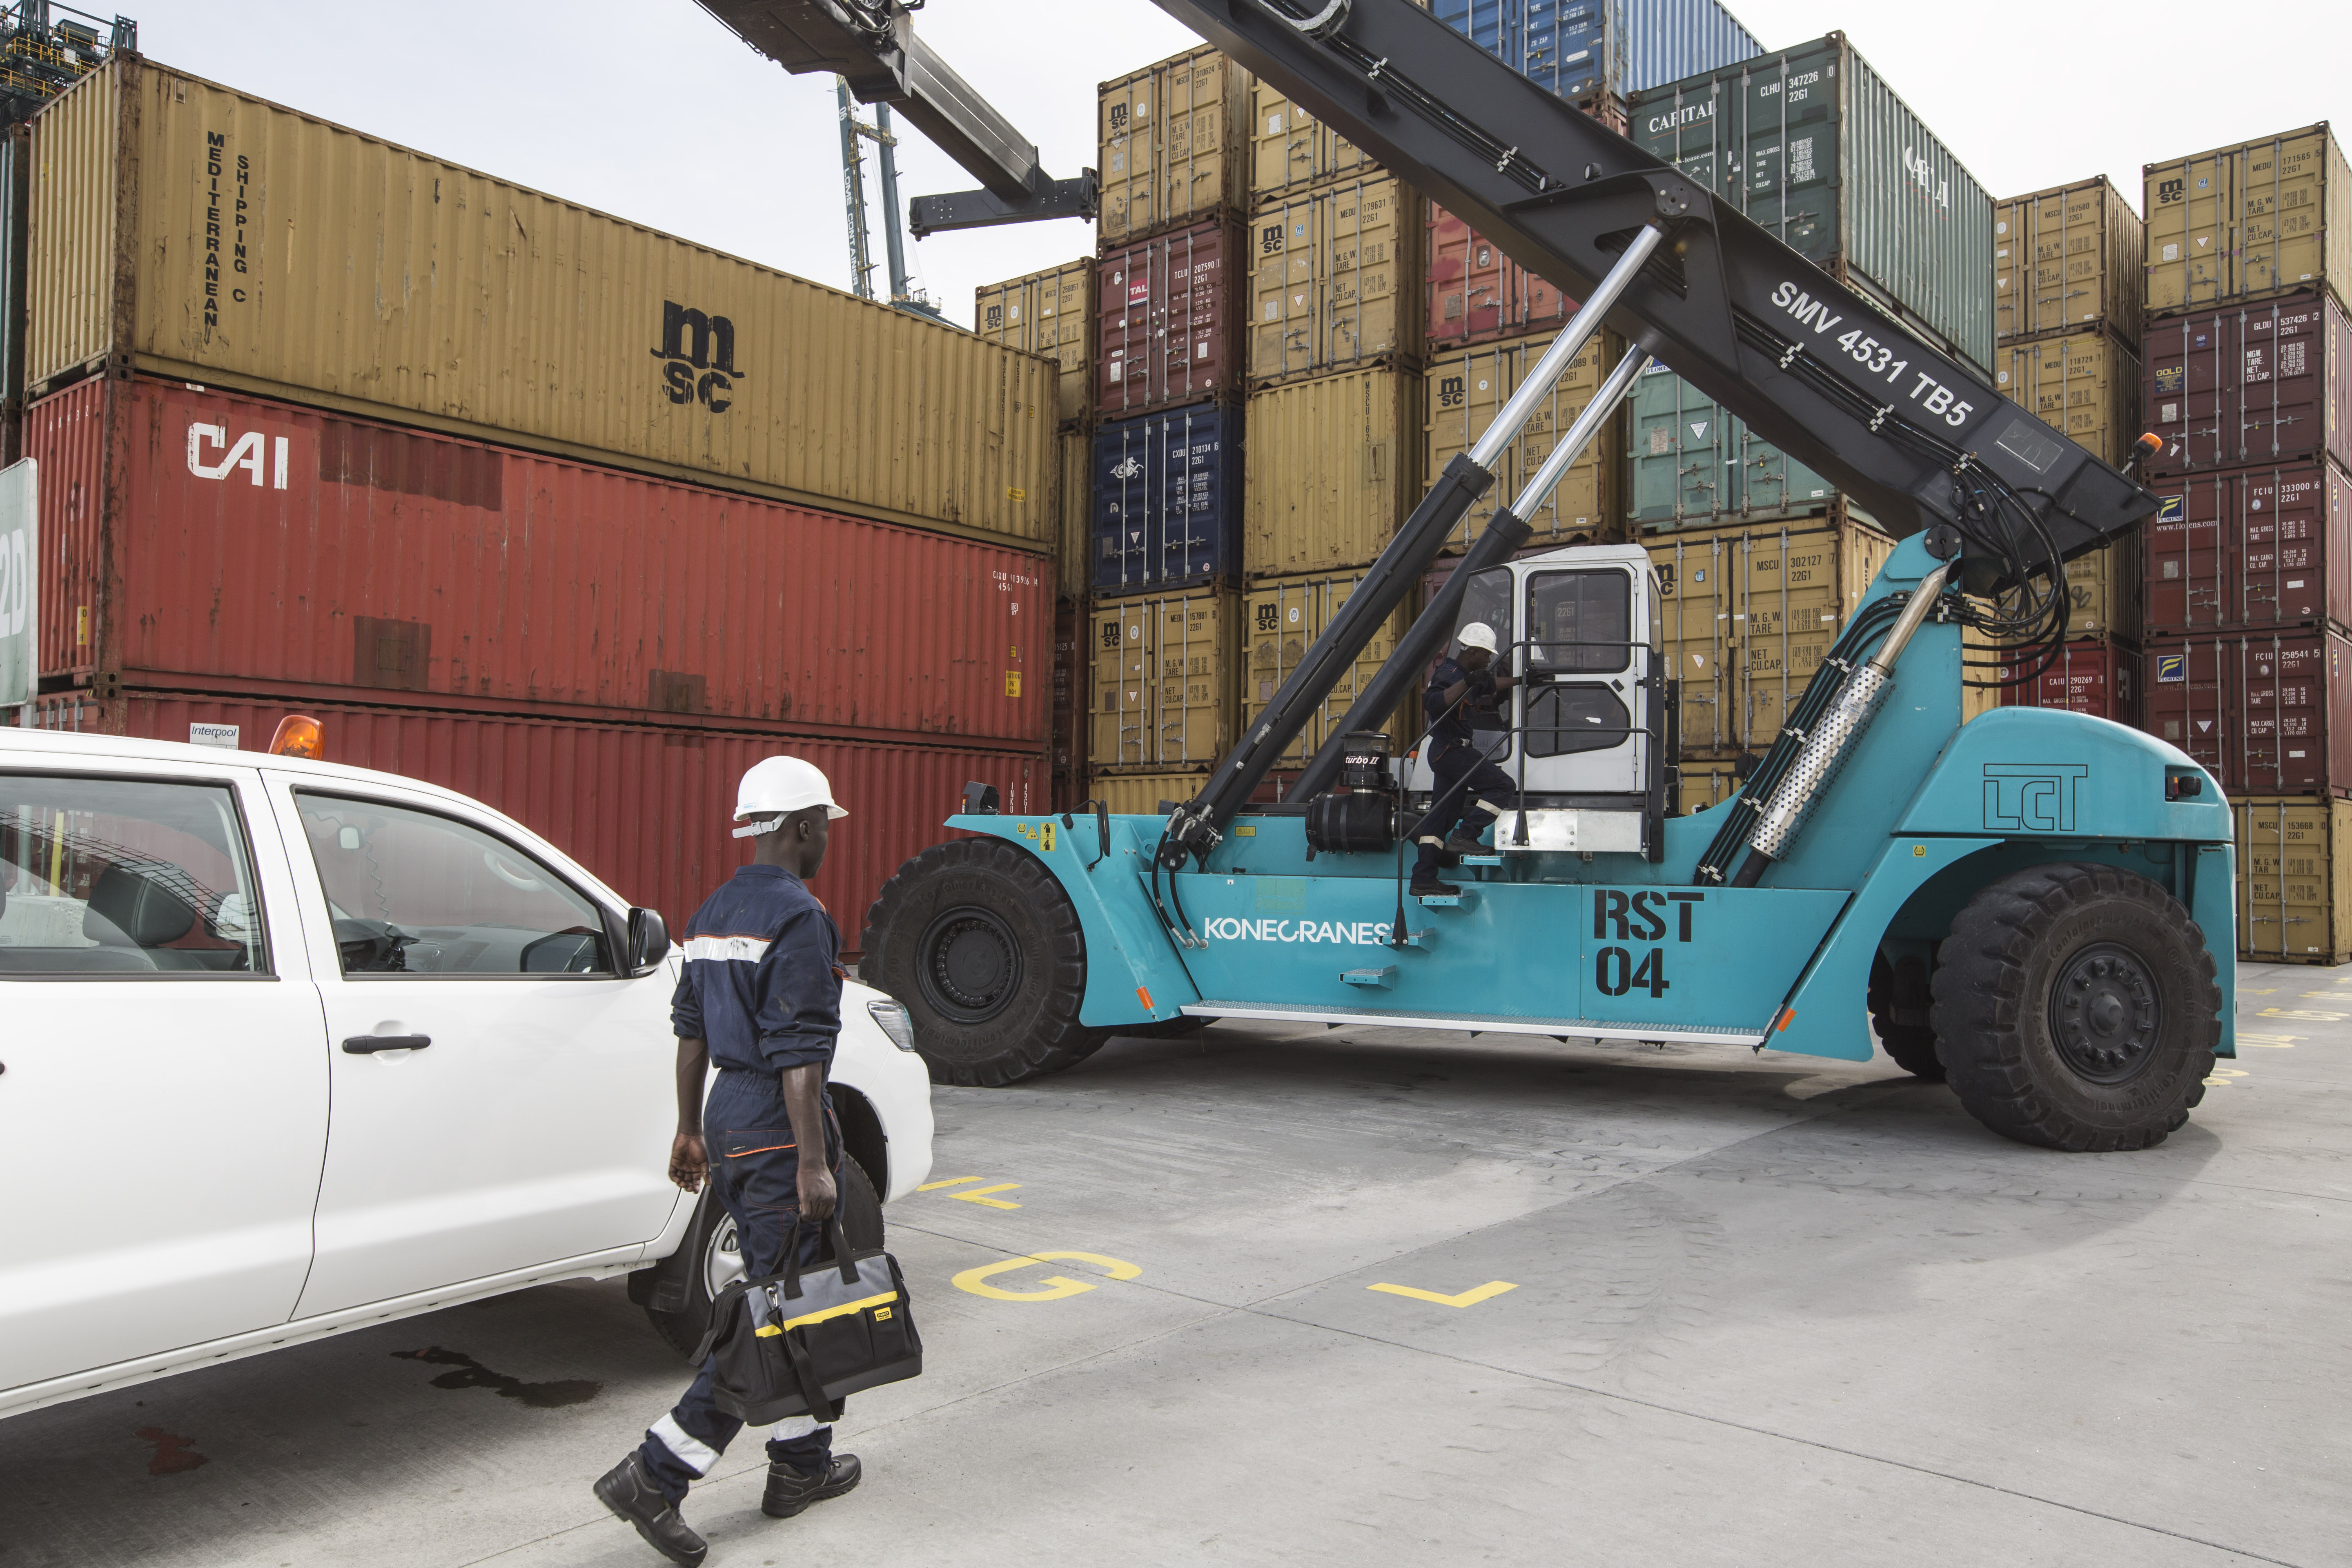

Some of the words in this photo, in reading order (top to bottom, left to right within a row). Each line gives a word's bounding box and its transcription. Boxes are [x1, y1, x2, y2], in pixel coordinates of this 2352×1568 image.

[1531, 4, 1541, 13] TARE
[1176, 75, 1189, 86] MSCU
[1196, 65, 1214, 78] 310624
[1196, 78, 1207, 88] 22G1
[1761, 82, 1780, 97] CLHU
[1789, 71, 1818, 89] 347226
[1789, 88, 1807, 102] 22G1
[1172, 131, 1185, 140] TARE
[1172, 142, 1182, 151] NET
[2253, 162, 2271, 172] MEDU
[2283, 152, 2310, 165] 171565
[2283, 164, 2301, 174] 22G1
[234, 154, 249, 274] SHIPPING
[1341, 207, 1356, 219] MEDU
[1363, 199, 1385, 212] 179631
[2045, 209, 2061, 218] MSCU
[2068, 203, 2089, 213] 197580
[2248, 206, 2265, 215] TARE
[1363, 212, 1378, 223] 22G1
[2069, 213, 2082, 222] 22G1
[204, 131, 224, 327] MEDITERRANEAN
[2248, 225, 2261, 234] NET
[847, 212, 858, 287] CONTAINER
[2038, 251, 2054, 260] TARE
[1175, 268, 1187, 279] TCLU
[1194, 261, 1214, 274] 207590
[1336, 261, 1350, 271] TARE
[1194, 274, 1207, 284] 22G1
[1045, 289, 1056, 298] MSCU
[1062, 283, 1078, 294] 259051
[1130, 285, 1147, 295] TAL
[1336, 283, 1346, 293] NET
[1062, 294, 1073, 303] 22G1
[2254, 321, 2271, 330] GLDU
[2281, 315, 2307, 325] 537426
[2281, 326, 2297, 335] 22G1
[1771, 281, 1842, 334] SMV
[1837, 330, 1909, 383] 4531
[1910, 372, 1974, 427] TB5
[2247, 350, 2263, 358] MGW.
[2045, 361, 2061, 369] MEDU
[2070, 356, 2092, 365] 118729
[2247, 357, 2264, 366] TARE.
[2156, 367, 2182, 376] GOLD
[2247, 366, 2260, 374] NET.
[1561, 372, 1577, 383] 22G1
[2247, 372, 2271, 382] CU.CAP.
[2040, 402, 2054, 410] TARE
[1527, 422, 1544, 433] TARE
[1173, 449, 1185, 458] CXDU
[1192, 443, 1210, 454] 210134
[1527, 446, 1540, 457] NET
[187, 422, 289, 490] CAI
[1192, 456, 1204, 465] 22G1
[2254, 487, 2272, 496] FCIU
[2281, 483, 2310, 492] 333000
[2281, 493, 2299, 502] 22G1
[2156, 520, 2217, 531] www.floens.com
[1757, 559, 1779, 571] MSCU
[1791, 555, 1821, 568] 302127
[993, 570, 1006, 580] CAXU
[1010, 575, 1029, 585] 913926
[1792, 570, 1811, 581] 22G1
[1171, 614, 1183, 622] MEDU
[1190, 612, 1207, 621] 157881
[1190, 623, 1201, 631] 22G1
[1751, 624, 1772, 634] TARE
[1751, 649, 1767, 660] NET
[2282, 650, 2308, 659] 258544
[1165, 668, 1178, 676] TARE
[192, 726, 236, 737] Interpool
[1345, 756, 1368, 764] turbo
[1594, 889, 1704, 943] RST
[1595, 946, 1670, 998] 04
